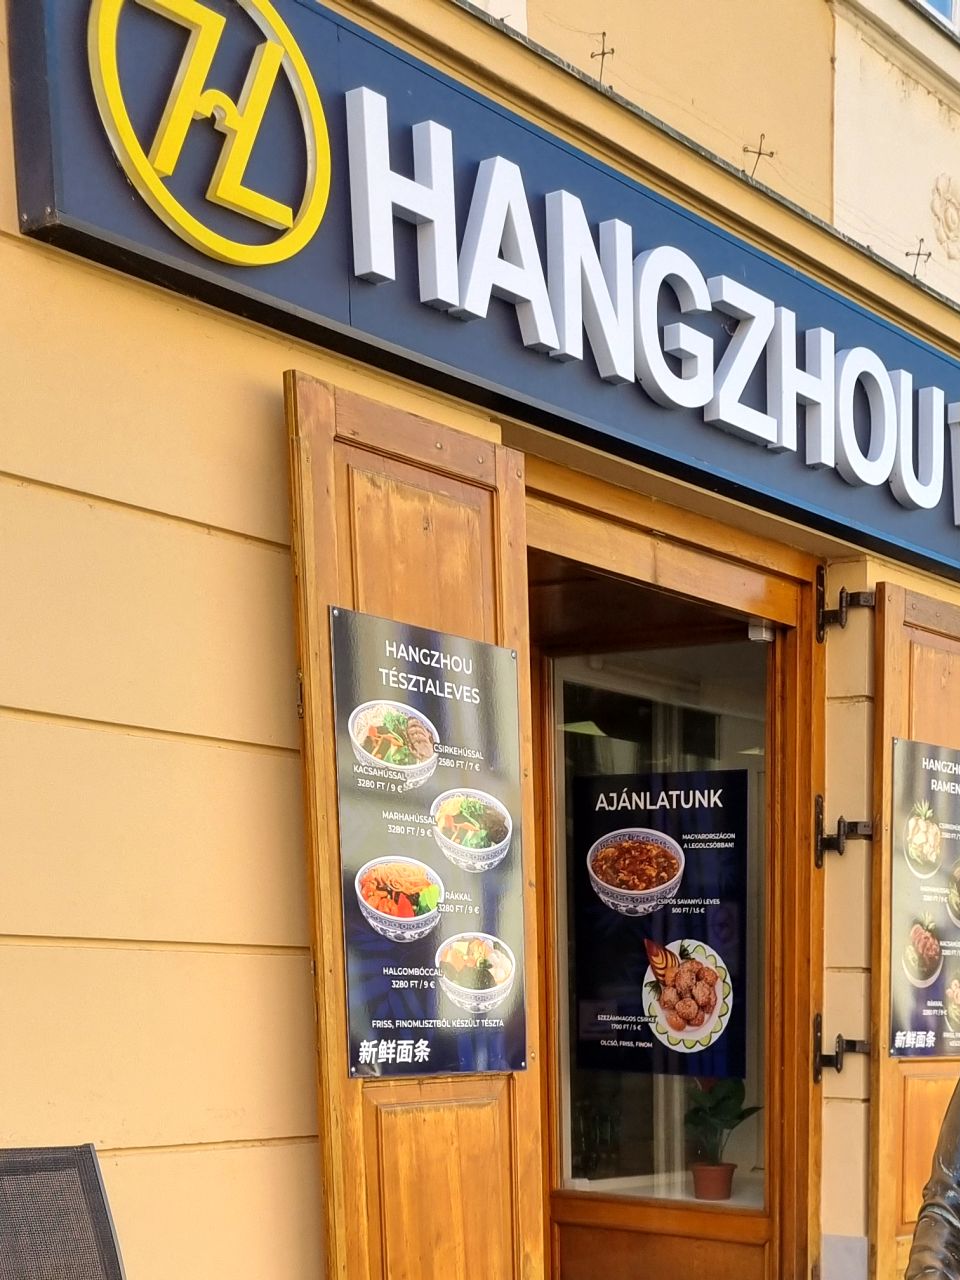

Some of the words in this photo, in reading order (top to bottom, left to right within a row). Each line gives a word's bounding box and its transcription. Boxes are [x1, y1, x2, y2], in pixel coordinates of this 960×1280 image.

[345, 86, 944, 509] HANGZHOU
[385, 640, 473, 675] HANGZHOU
[379, 664, 480, 704] TÉSZTALEVES
[433, 743, 484, 760] CSIRKEHÚSSAL
[353, 764, 406, 781] KACSAHÚSSAL
[455, 759, 465, 769] FT
[469, 761, 473, 770] 7
[474, 762, 480, 771] €
[357, 778, 375, 788] 3280
[376, 781, 385, 790] FT
[391, 783, 396, 792] 9
[396, 784, 403, 793] €
[595, 787, 724, 811] AJÁNLATUNK
[382, 810, 437, 825] MARHAHÚSSAL
[388, 824, 405, 834] 3280
[406, 826, 416, 835] FT
[420, 827, 425, 836] 9
[426, 828, 433, 837] €
[682, 832, 736, 840] MAGYARORSZÁGON
[445, 890, 472, 902] RÁKKAL
[438, 904, 454, 913] 3280
[455, 905, 464, 913] FT
[468, 906, 473, 914] 9
[474, 906, 480, 914] €
[391, 980, 409, 988] 3280
[410, 980, 419, 989] FT
[429, 981, 435, 989] €
[894, 1030, 936, 1048] 新鲜面条
[358, 1038, 431, 1064] 新鲜面条
